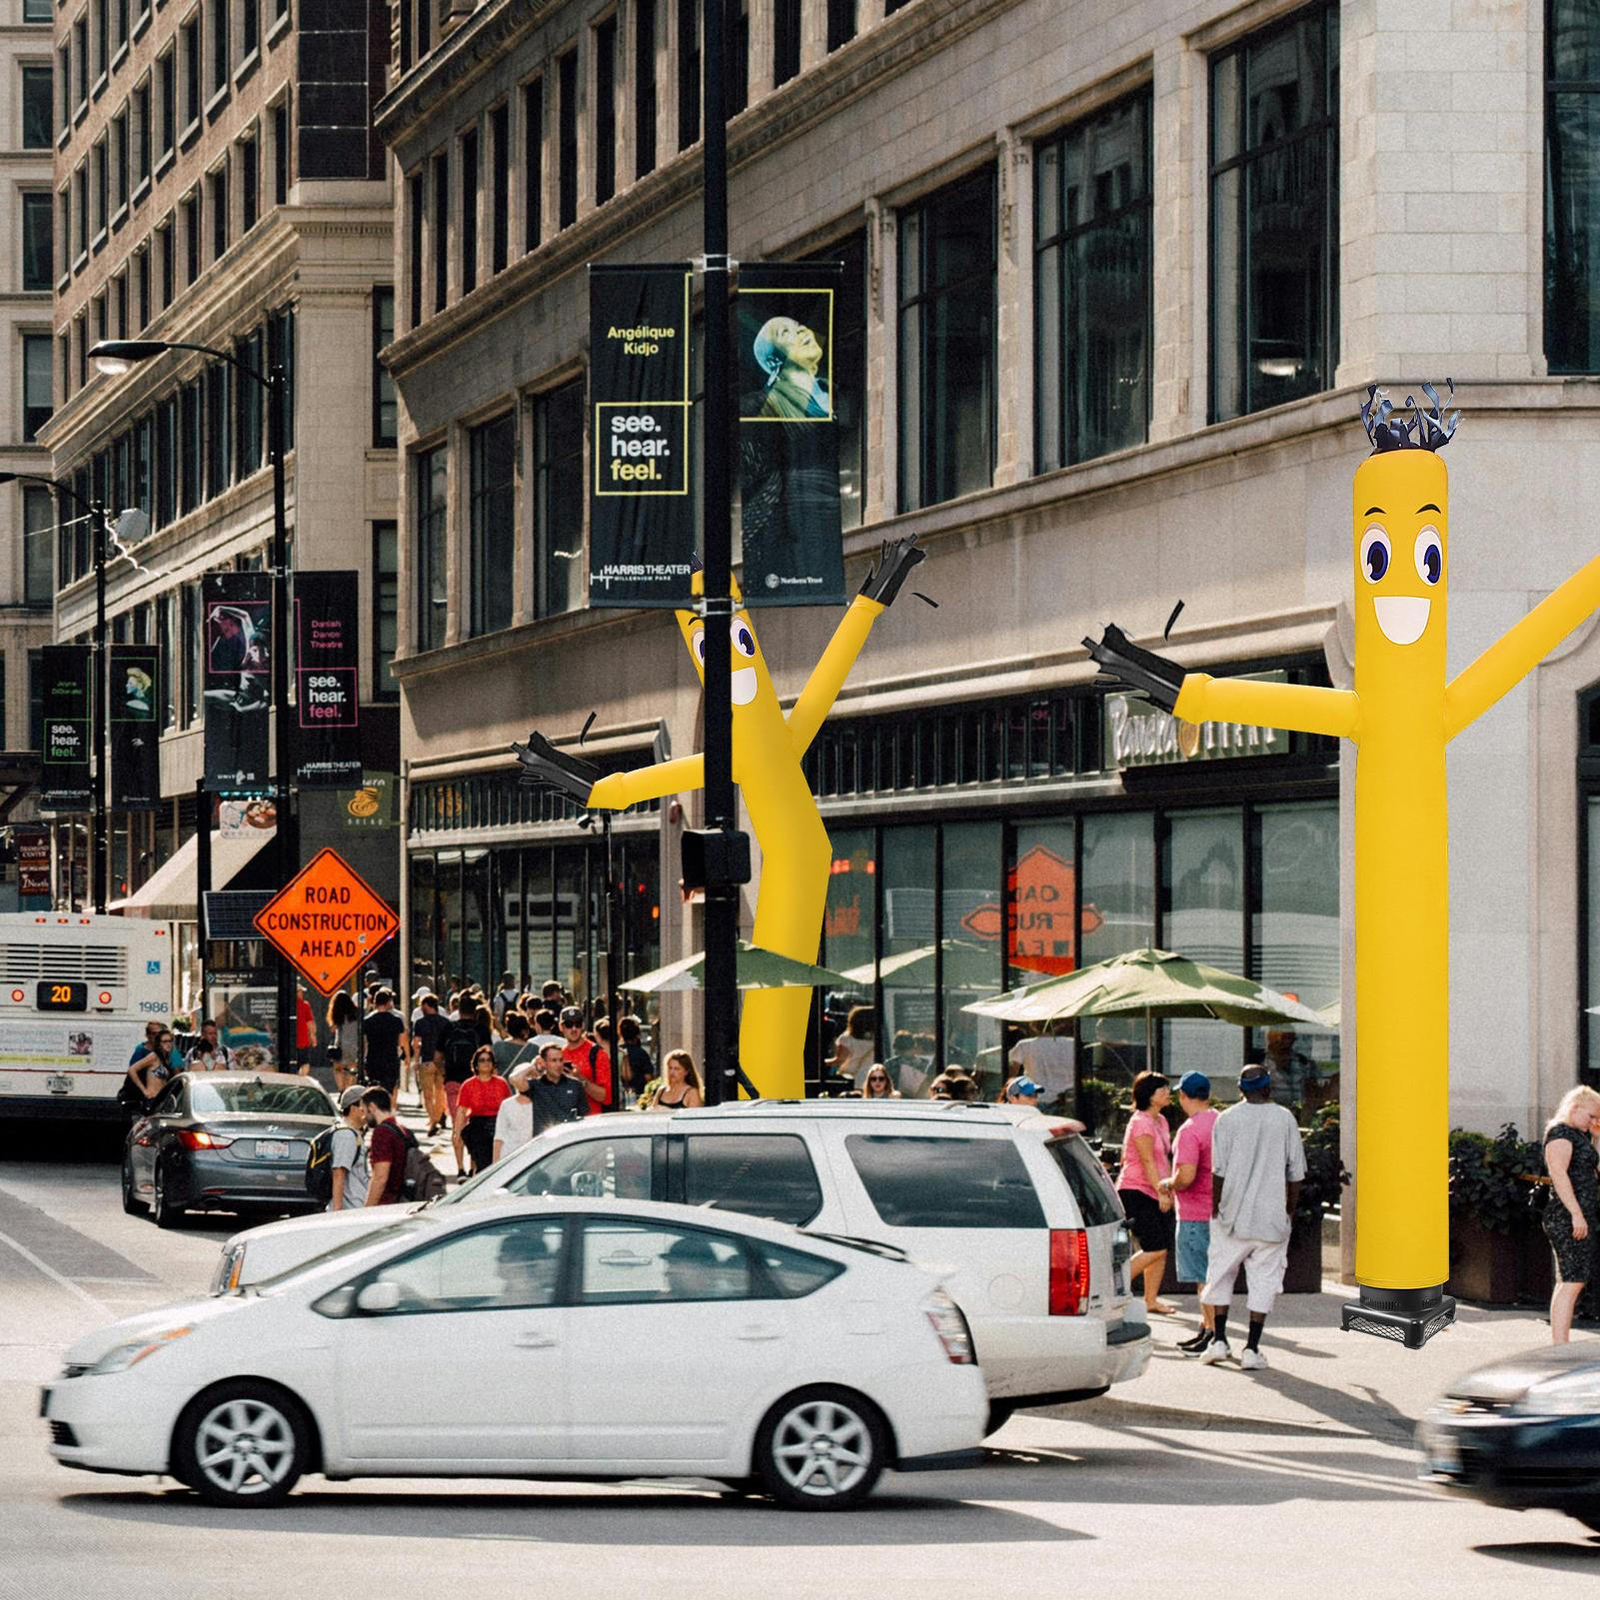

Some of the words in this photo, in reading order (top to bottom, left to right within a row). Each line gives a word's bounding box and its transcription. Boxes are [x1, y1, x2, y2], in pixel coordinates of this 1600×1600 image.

[607, 326, 675, 341] Angélique
[624, 342, 659, 356] Kidjo
[611, 415, 661, 432] see.
[611, 435, 670, 457] hear.
[611, 458, 662, 481] feel.
[604, 564, 645, 575] HARRIS
[645, 563, 691, 574] THEATER
[311, 620, 341, 628] Danish
[308, 676, 341, 687] see.
[308, 689, 347, 703] hear.
[308, 704, 342, 718] feel.
[51, 725, 76, 734] see.
[51, 734, 81, 746] hear.
[51, 746, 76, 757] feel.
[305, 886, 350, 904] ROAD
[267, 913, 388, 931] CONSTRUCTION
[300, 940, 356, 957] AHEAD
[51, 986, 71, 1003] 20
[139, 1001, 169, 1013] 1986
